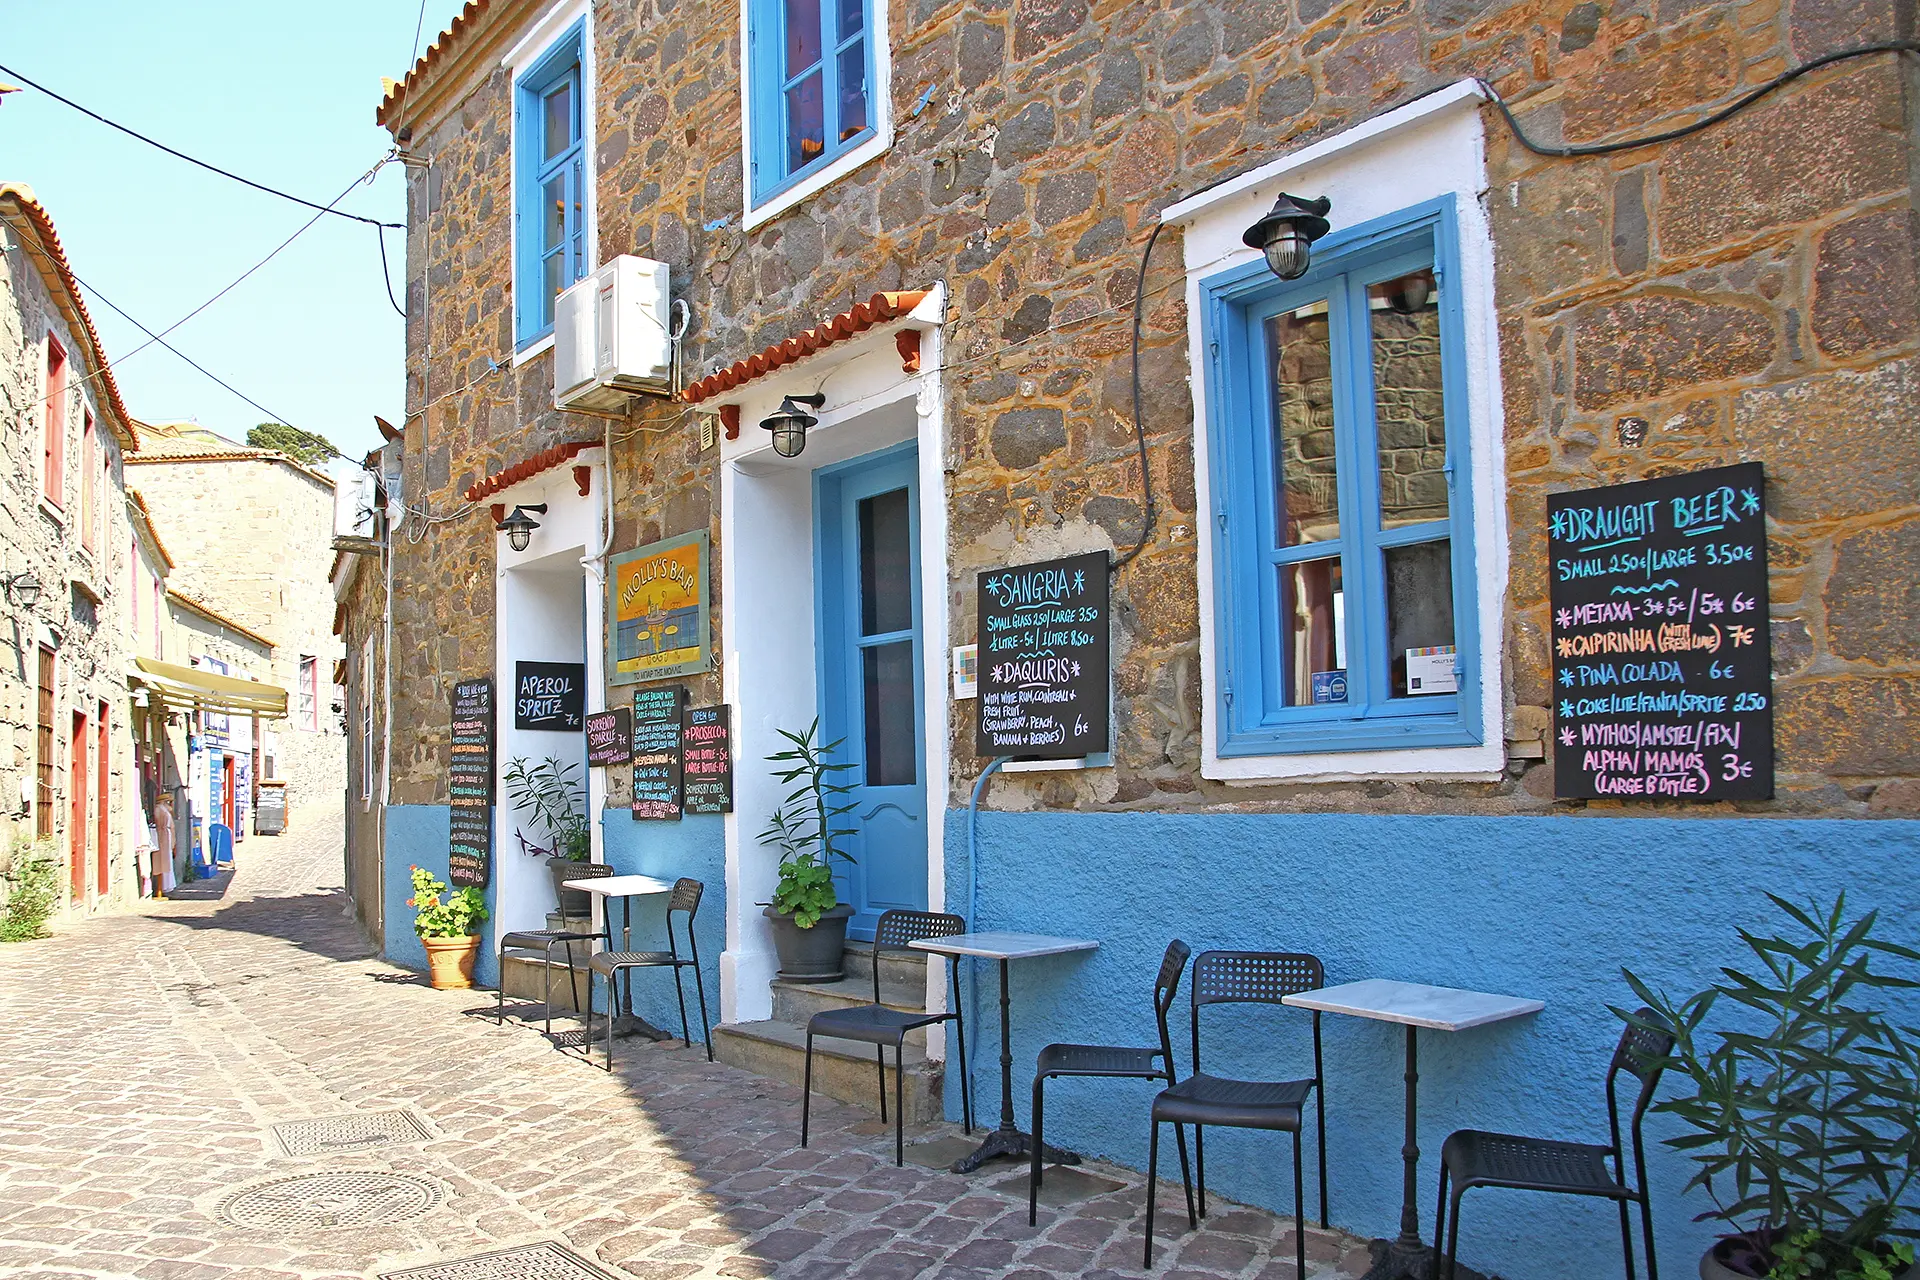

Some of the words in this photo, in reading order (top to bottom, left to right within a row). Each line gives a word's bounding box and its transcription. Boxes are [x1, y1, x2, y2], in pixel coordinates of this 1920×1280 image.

[1563, 500, 1659, 543] DRAUGHT
[1670, 486, 1741, 528] BEER
[1557, 559, 1606, 581] SMALL
[621, 557, 667, 609] MOLLY'S
[669, 559, 694, 597] BAR
[1000, 568, 1070, 607] SANGRIA
[1731, 591, 1755, 614] 6€
[987, 615, 1012, 632] SMALL
[1012, 613, 1032, 628] GLASS
[1571, 627, 1655, 657] CAIPIRINHA
[1725, 625, 1755, 648] 7€
[1003, 657, 1070, 684] DAQUIRIS
[1576, 663, 1620, 687] PINA
[1621, 660, 1685, 684] COLADA
[1708, 660, 1735, 680] 6€
[521, 675, 573, 696] APEROL
[518, 698, 563, 717] SPRITZ
[983, 692, 999, 705] WITH
[565, 713, 579, 726] 7€
[983, 706, 1001, 717] FRESH
[587, 715, 616, 734] SORRENTO
[690, 726, 722, 741] PROSECCO
[1074, 713, 1089, 737] 6€
[590, 729, 616, 746] SPARKLE
[618, 733, 627, 745] 7€
[993, 732, 1022, 747] BANANA
[685, 749, 700, 761] SMALL
[719, 747, 728, 761] 5€
[685, 762, 701, 774] LARGE
[1645, 750, 1705, 773] MAMOS
[1721, 753, 1753, 782] 3€
